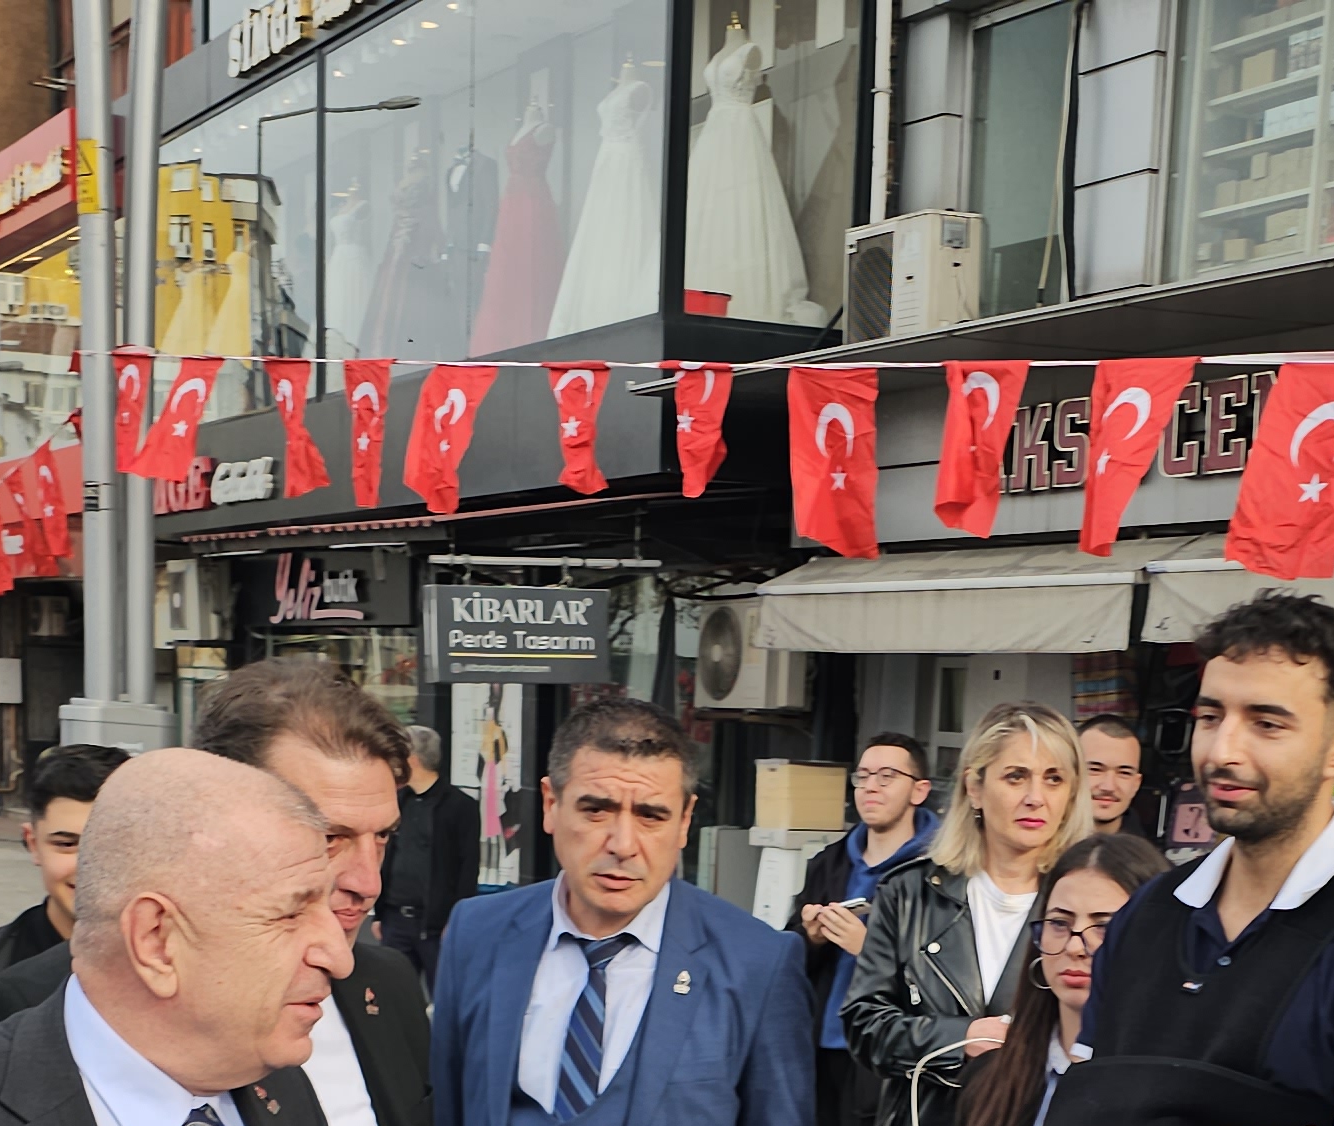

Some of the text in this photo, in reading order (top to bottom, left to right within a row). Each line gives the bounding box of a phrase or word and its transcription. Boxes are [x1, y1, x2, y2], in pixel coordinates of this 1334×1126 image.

[998, 396, 1091, 495] KS
[451, 592, 589, 626] KİBARLAR
[448, 630, 596, 651] Perde Tasarım
